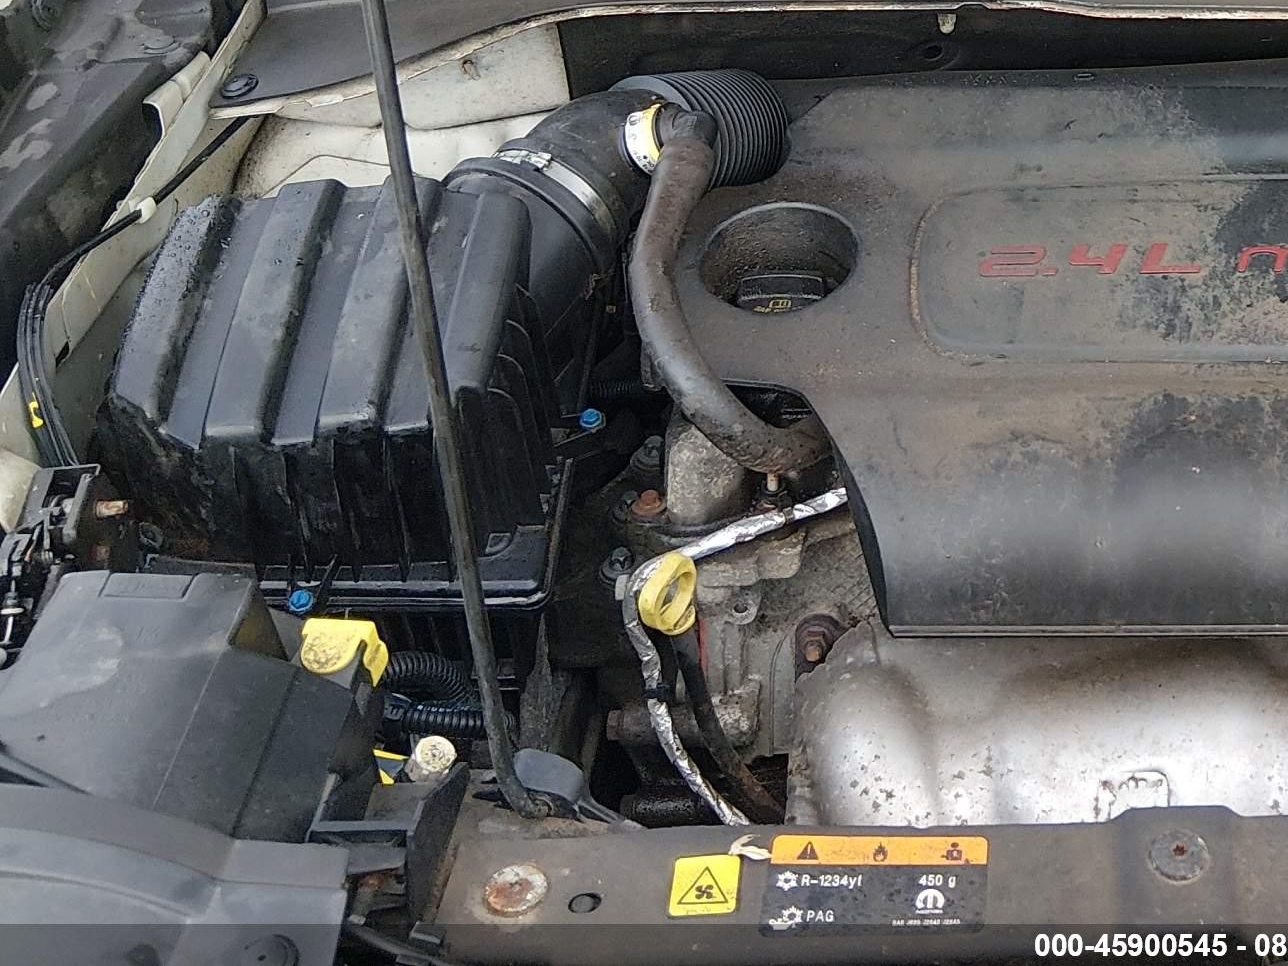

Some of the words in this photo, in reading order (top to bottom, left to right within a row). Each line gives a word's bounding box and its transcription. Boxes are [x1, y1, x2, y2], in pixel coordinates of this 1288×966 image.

[801, 874, 863, 889] R-1234yf
[918, 874, 943, 887] 450
[947, 875, 957, 889] g
[806, 910, 835, 923] PAG
